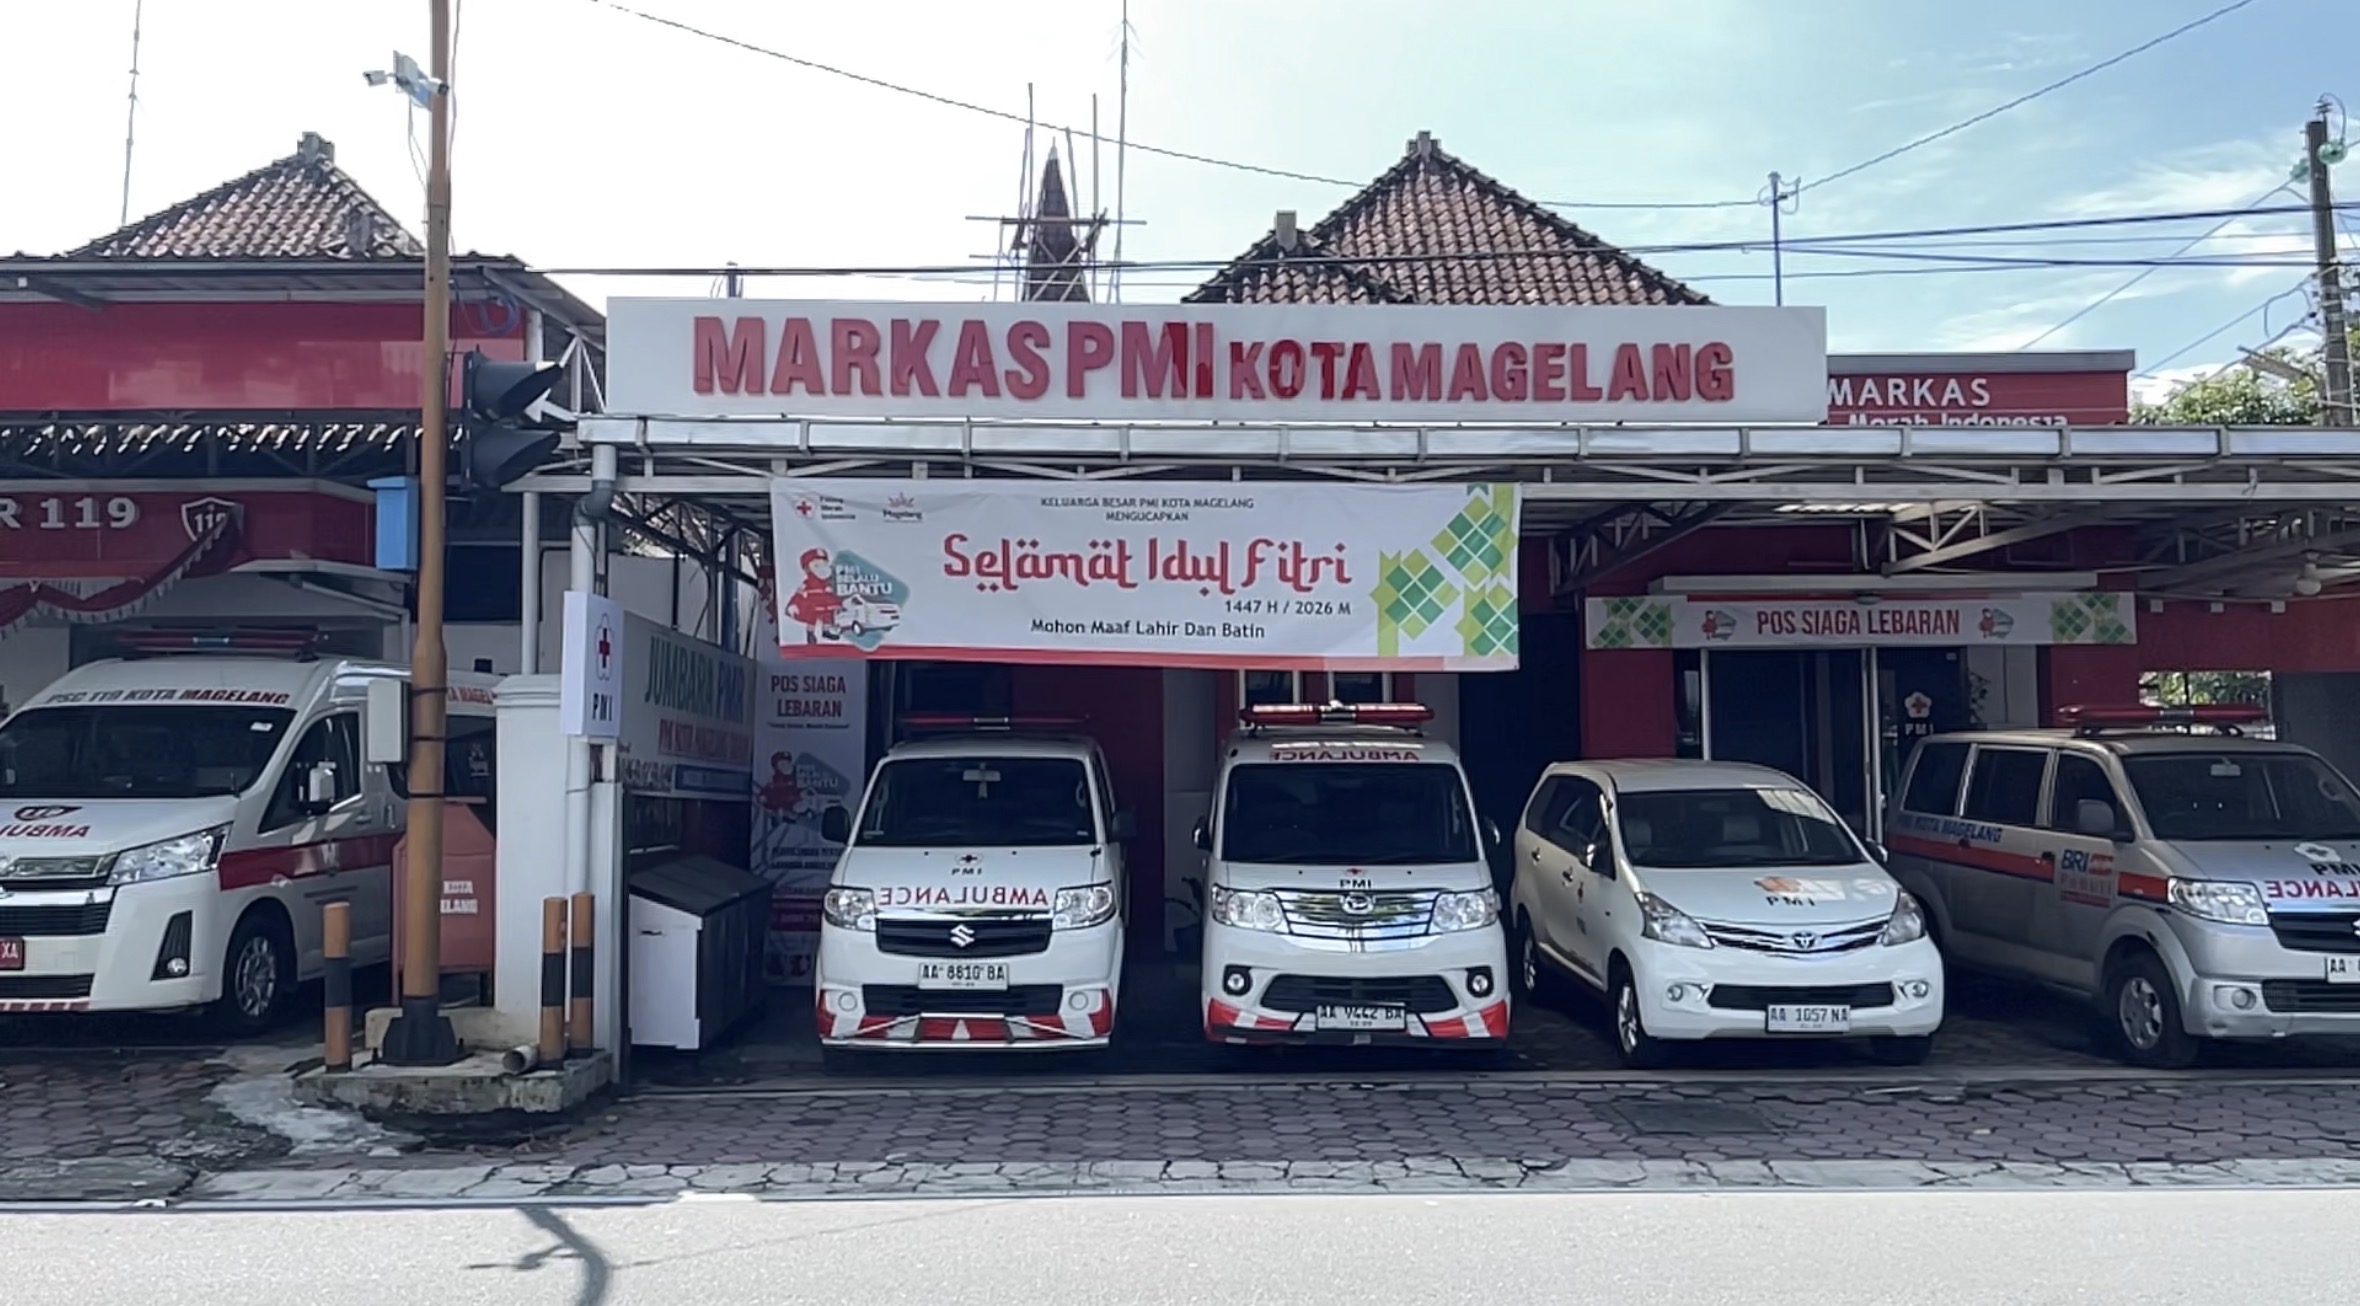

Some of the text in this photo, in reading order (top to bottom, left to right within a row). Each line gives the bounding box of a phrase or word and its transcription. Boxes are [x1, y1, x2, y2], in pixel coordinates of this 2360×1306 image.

[693, 316, 1734, 402] MARKAS PMI KOTA MAGELANG
[1827, 377, 1991, 407] MARKAS
[1041, 497, 1254, 509] KELUARGA BESAR PMI KOTA MAGELANG
[40, 497, 138, 529] 119
[1106, 511, 1189, 521] MENGUCAPKAN
[1148, 537, 1235, 597] Idul
[837, 582, 892, 597] BANTU
[1225, 600, 1261, 613] 1447
[1267, 601, 1278, 614] H
[1295, 601, 1333, 615] 2026
[1338, 602, 1351, 615] M
[1031, 618, 1265, 638] Mohon Maaf Lahir Dan Batin
[1757, 609, 1960, 635] POS SIAGA LEBARAN
[771, 675, 846, 694] POS SIAGA
[125, 689, 177, 701] KOTA
[178, 690, 290, 705] MAGELANG
[592, 693, 613, 722] PMI
[777, 699, 842, 718] LEBARAN
[1942, 820, 2003, 844] MAGELANG
[2061, 850, 2089, 873] BRI
[1340, 880, 1372, 889] PMI
[1766, 896, 1815, 906] PMI
[1, 942, 19, 958] XA
[922, 965, 939, 979] AA
[987, 966, 1005, 981] BA
[2330, 959, 2347, 973] AA
[1770, 1007, 1848, 1022] AA 1057 NA
